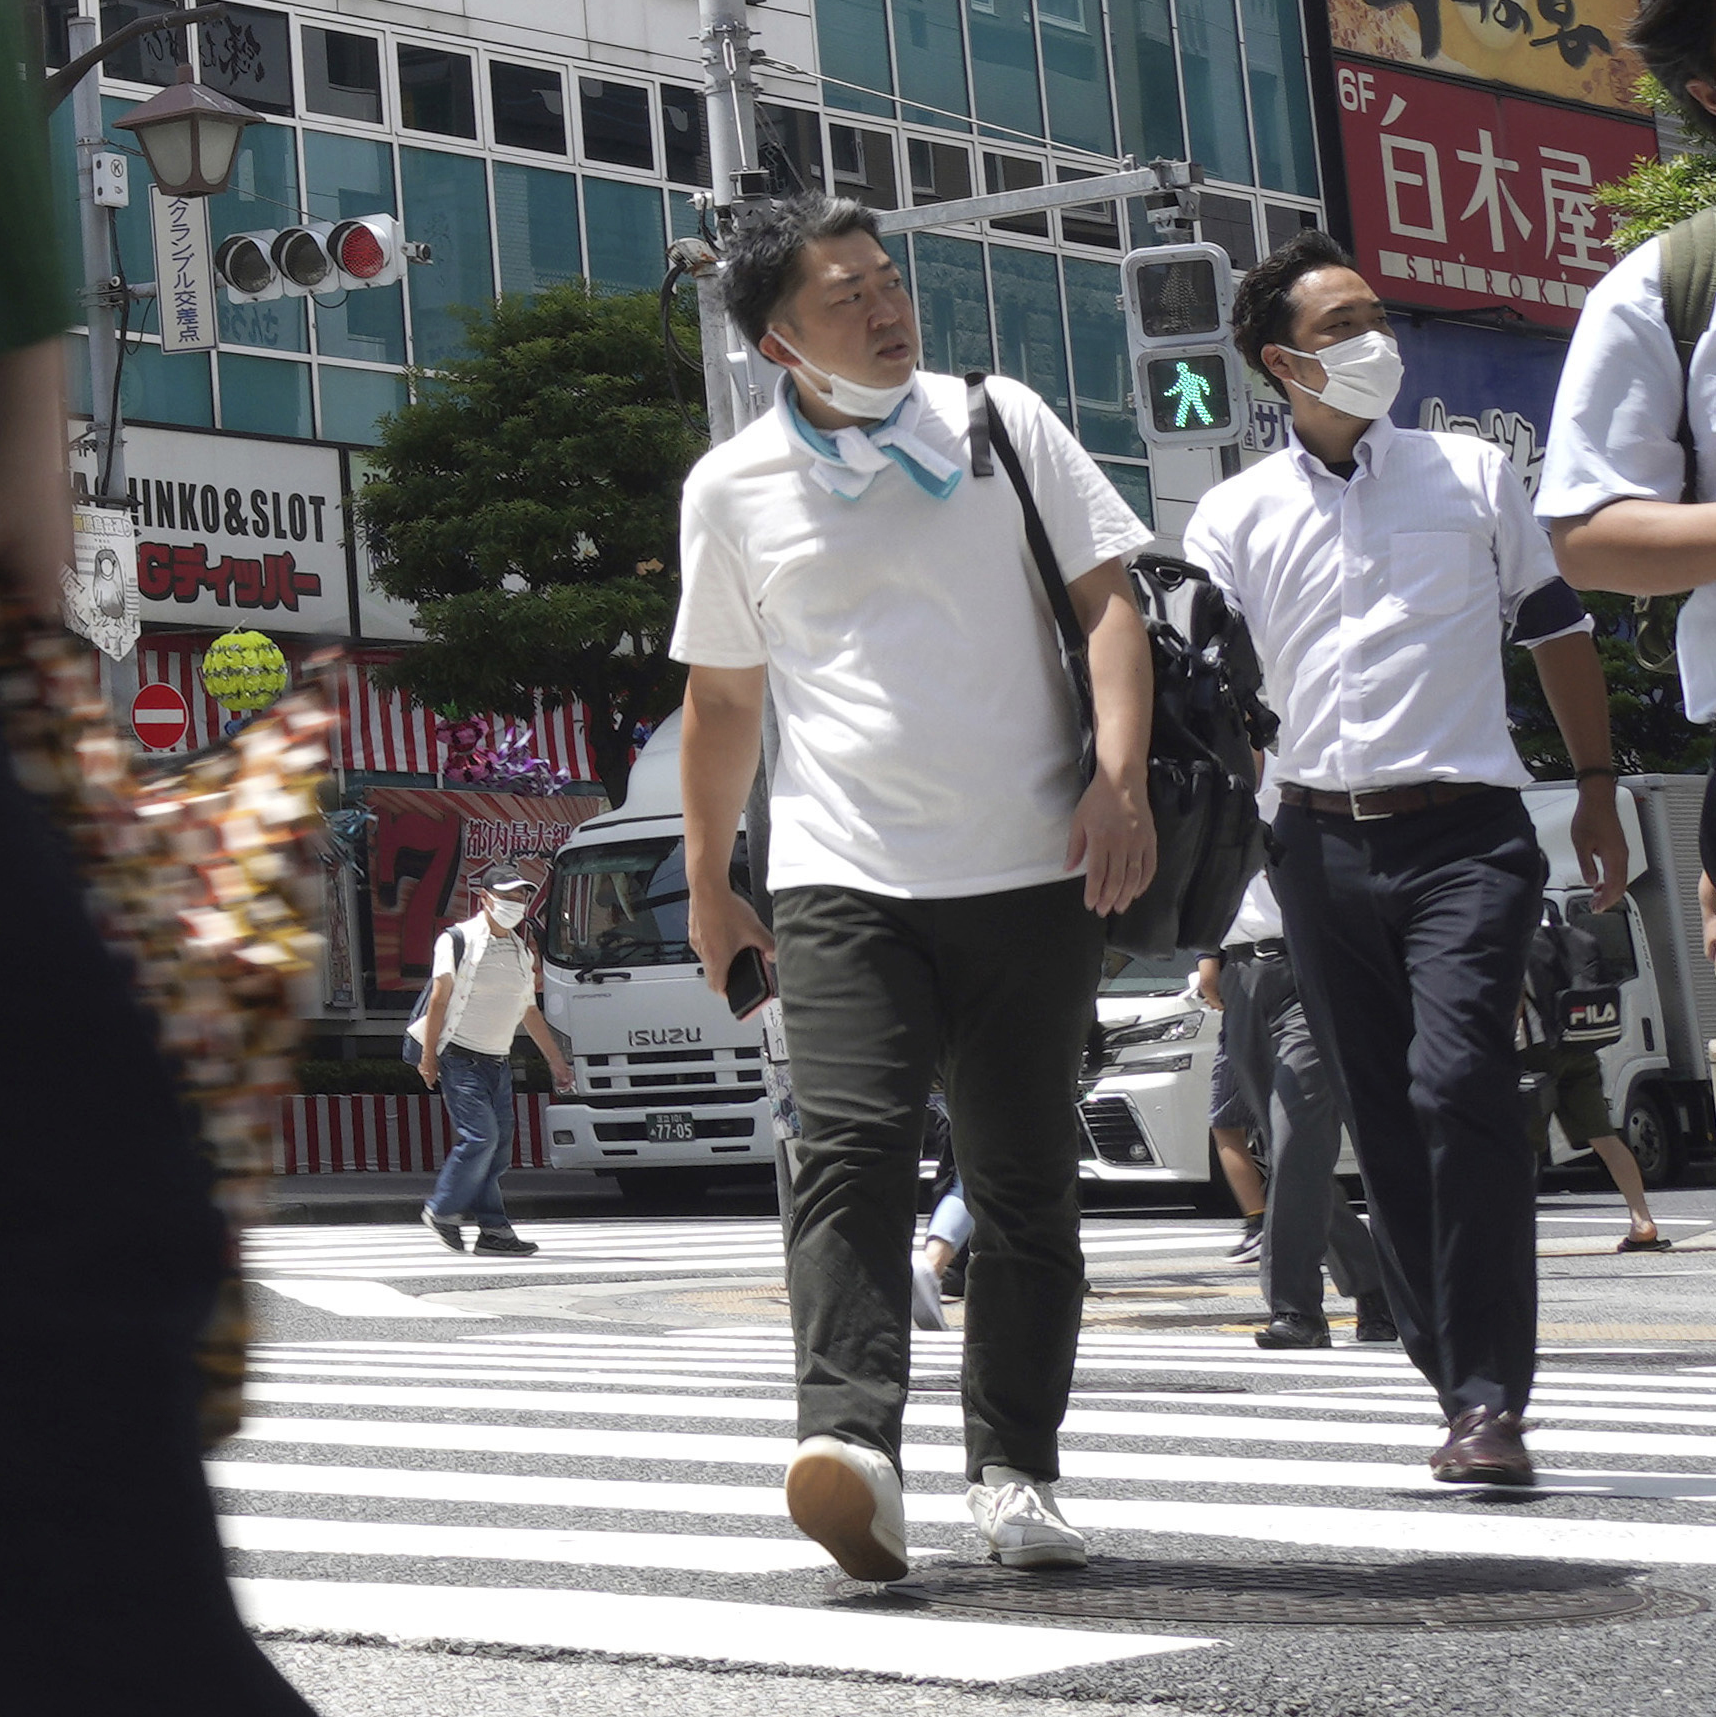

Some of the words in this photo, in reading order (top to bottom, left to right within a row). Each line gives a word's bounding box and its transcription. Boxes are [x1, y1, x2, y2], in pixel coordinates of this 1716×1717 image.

[1338, 67, 1375, 115] 6F
[1378, 94, 1610, 274] 白木屋
[137, 540, 322, 612] Gディッパー
[628, 1026, 703, 1047] ISUZU
[1570, 1001, 1617, 1026] FILA
